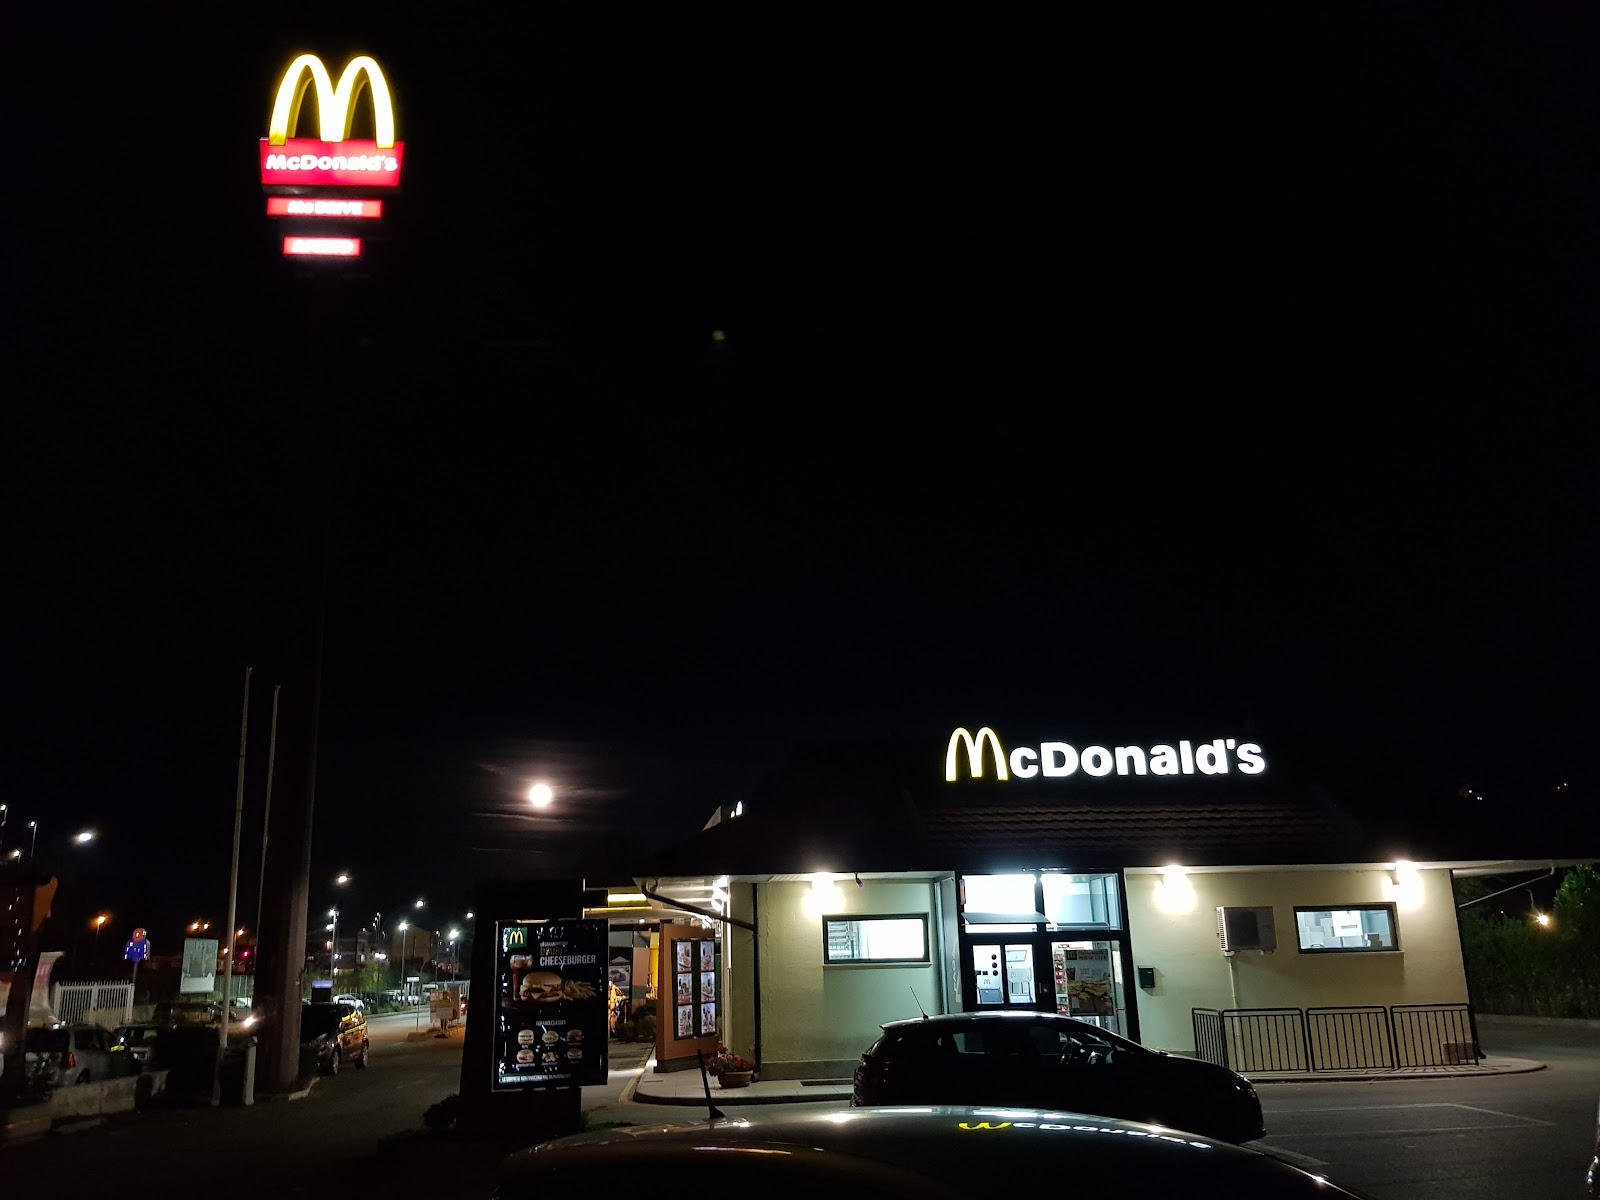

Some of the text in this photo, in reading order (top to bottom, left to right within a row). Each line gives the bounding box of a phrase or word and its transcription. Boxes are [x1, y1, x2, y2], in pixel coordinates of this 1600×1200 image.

[265, 154, 398, 172] McDonald's
[944, 726, 1267, 782] McDonald's
[539, 954, 597, 967] CHEESEBURGER
